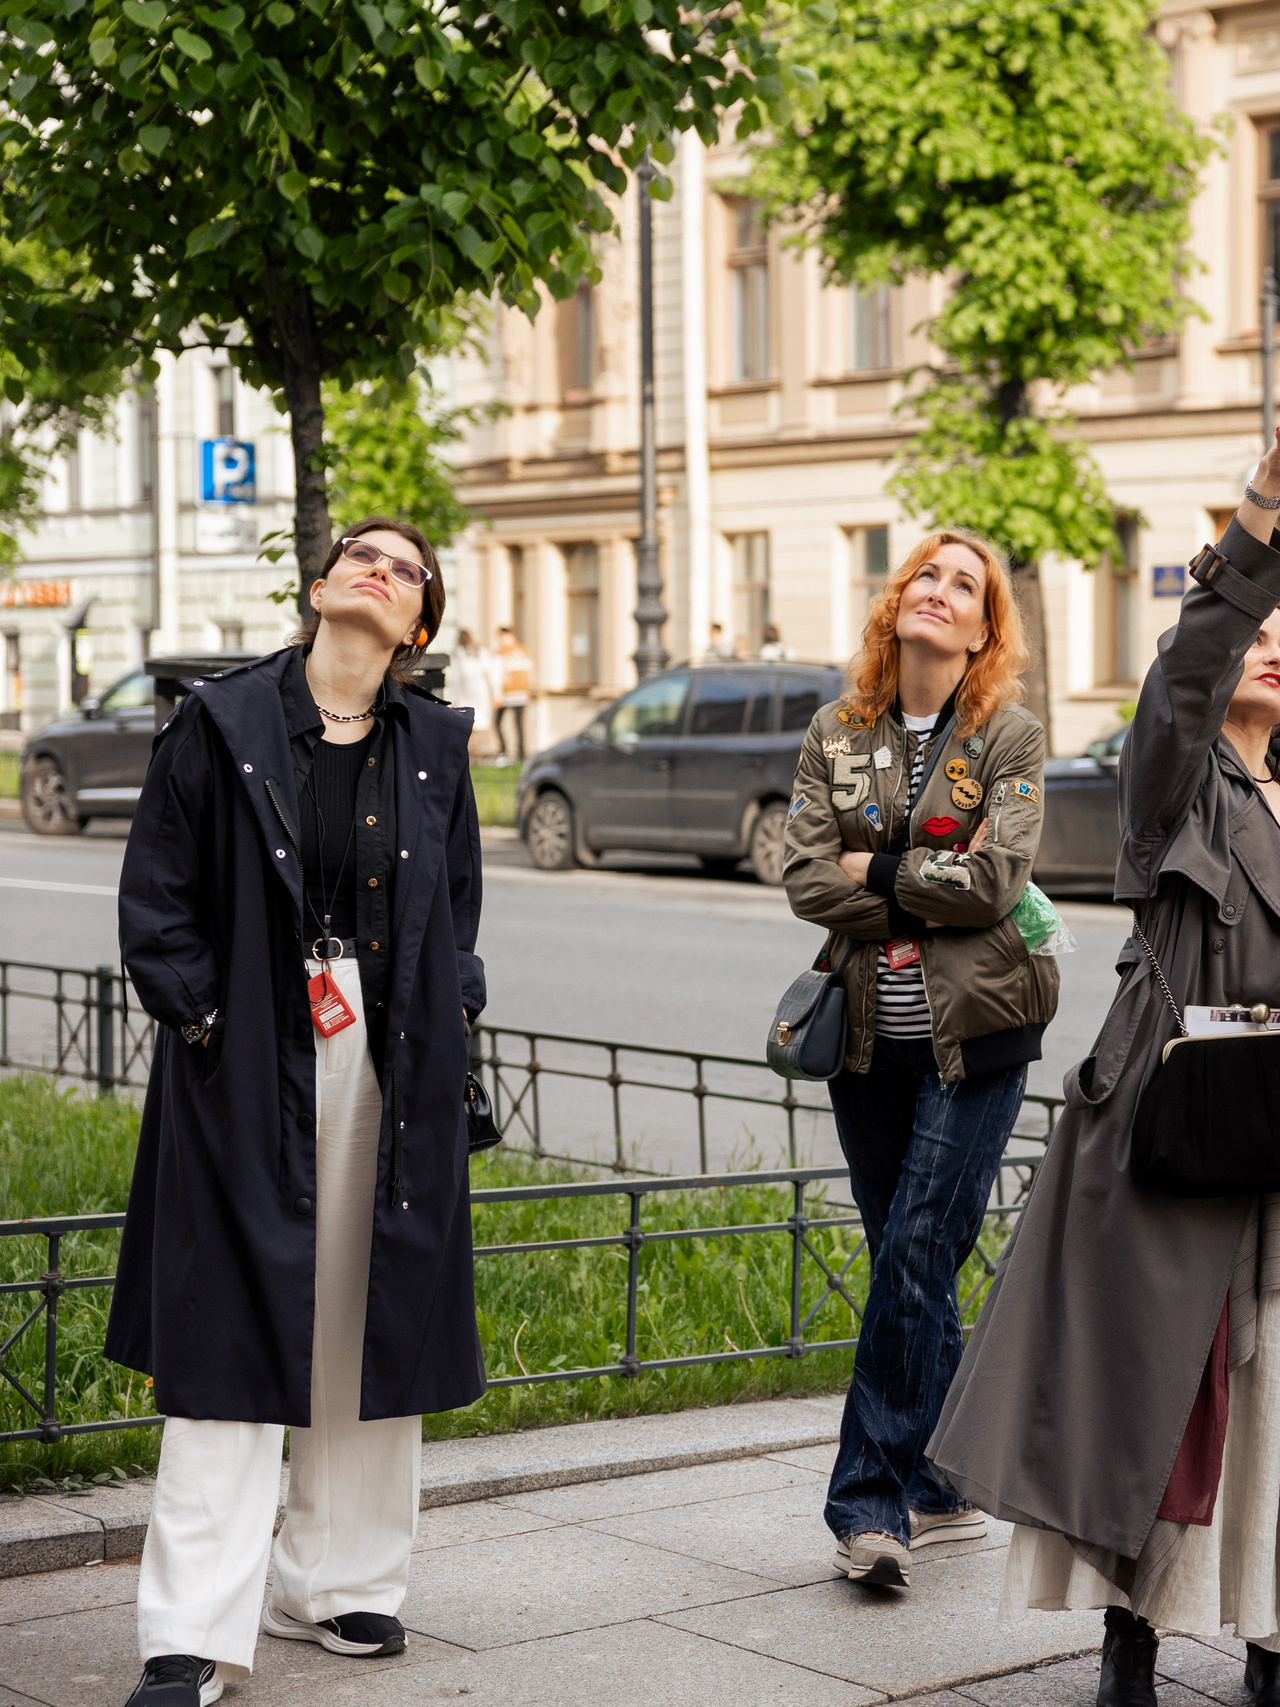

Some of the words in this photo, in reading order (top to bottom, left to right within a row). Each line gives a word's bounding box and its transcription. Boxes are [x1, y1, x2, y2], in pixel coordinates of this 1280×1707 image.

[212, 442, 250, 500] P
[831, 753, 872, 812] 5
[1016, 782, 1038, 800] 1974
